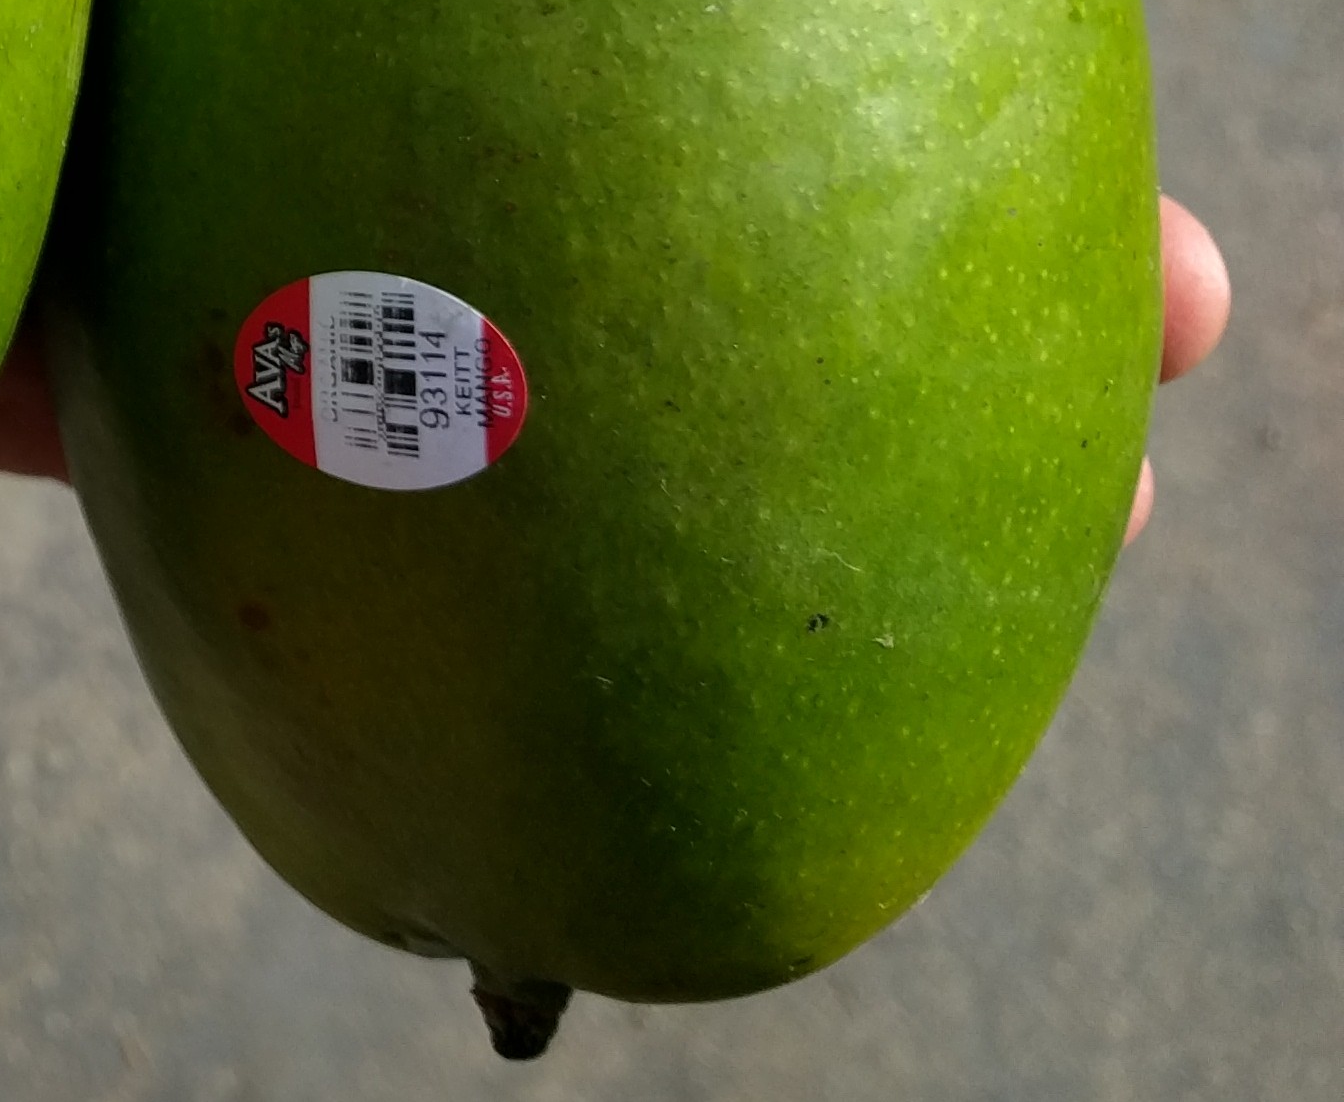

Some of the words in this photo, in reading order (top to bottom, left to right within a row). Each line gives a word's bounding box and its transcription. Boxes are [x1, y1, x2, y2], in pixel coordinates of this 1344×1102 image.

[419, 331, 450, 430] 93114
[454, 346, 473, 416] KEITT
[474, 338, 493, 429] MANGO
